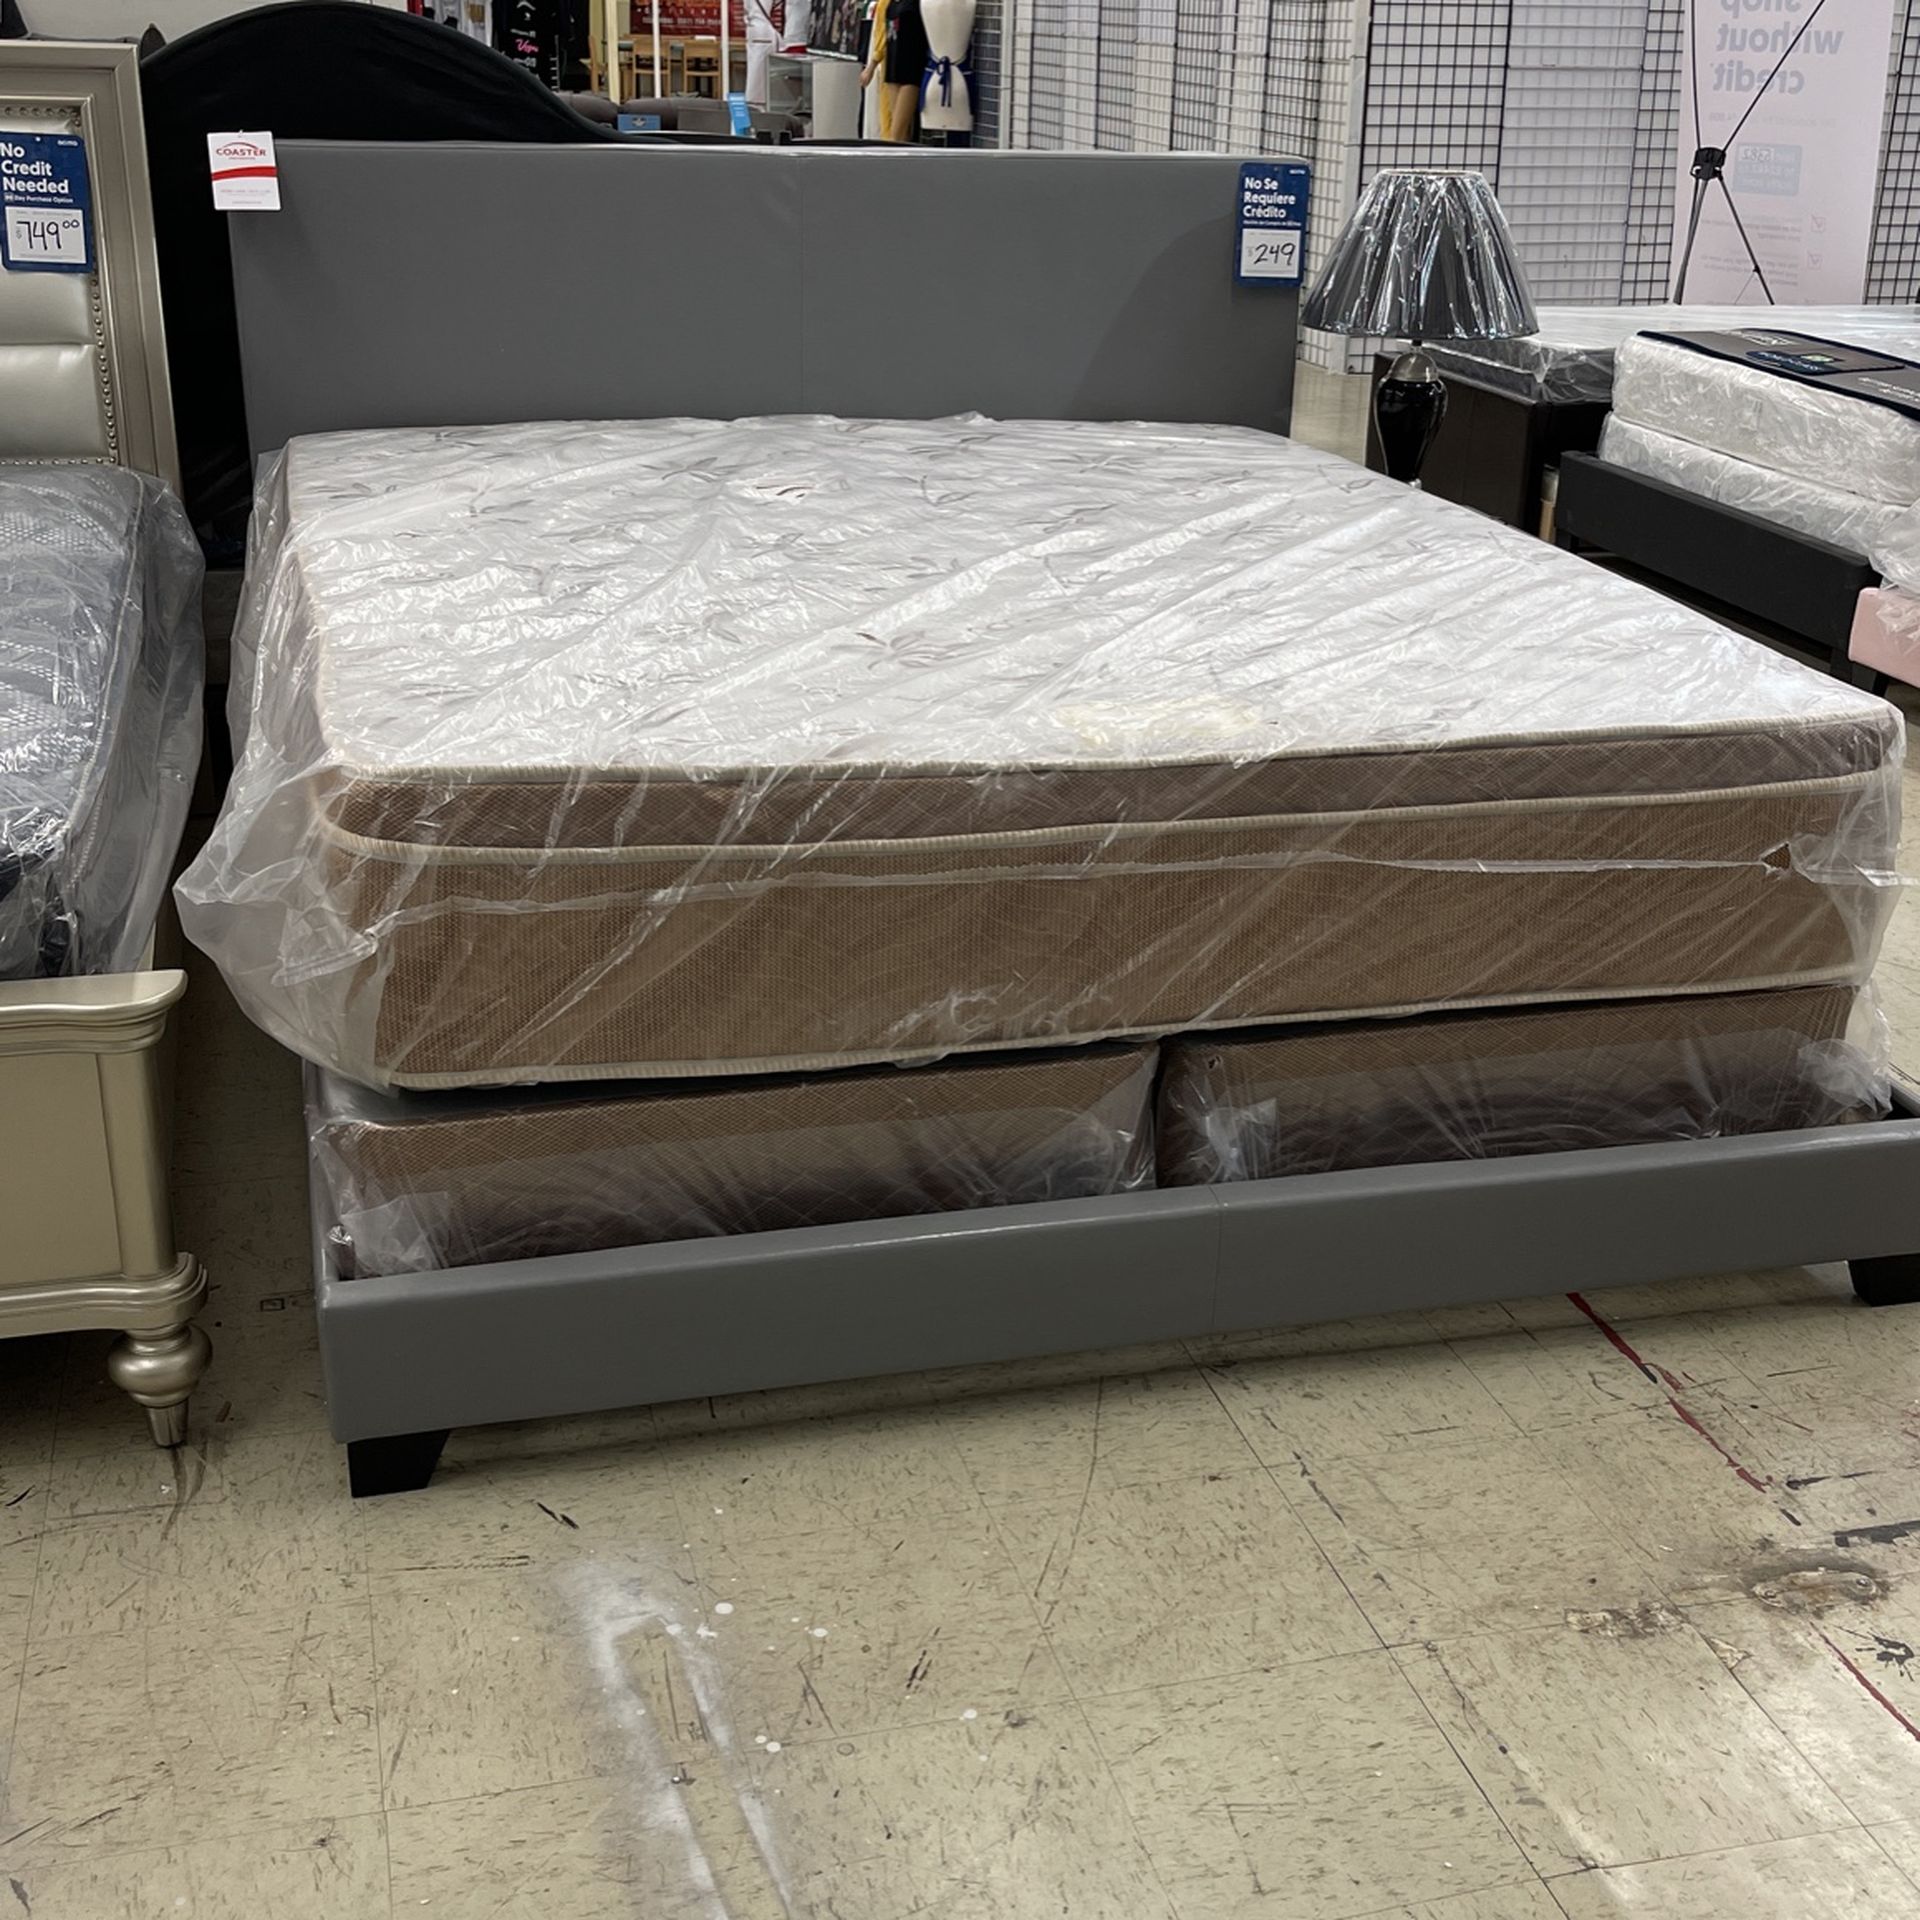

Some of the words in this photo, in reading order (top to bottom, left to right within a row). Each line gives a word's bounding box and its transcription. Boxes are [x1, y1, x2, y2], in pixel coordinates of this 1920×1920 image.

[0, 142, 25, 158] No
[216, 148, 267, 156] COASTER
[1, 160, 52, 176] Credit
[3, 177, 69, 194] Needed
[1244, 177, 1262, 190] No
[1263, 177, 1279, 190] Se
[1243, 191, 1296, 206] Requiere
[1243, 204, 1287, 219] Crédito
[1253, 242, 1297, 266] 249
